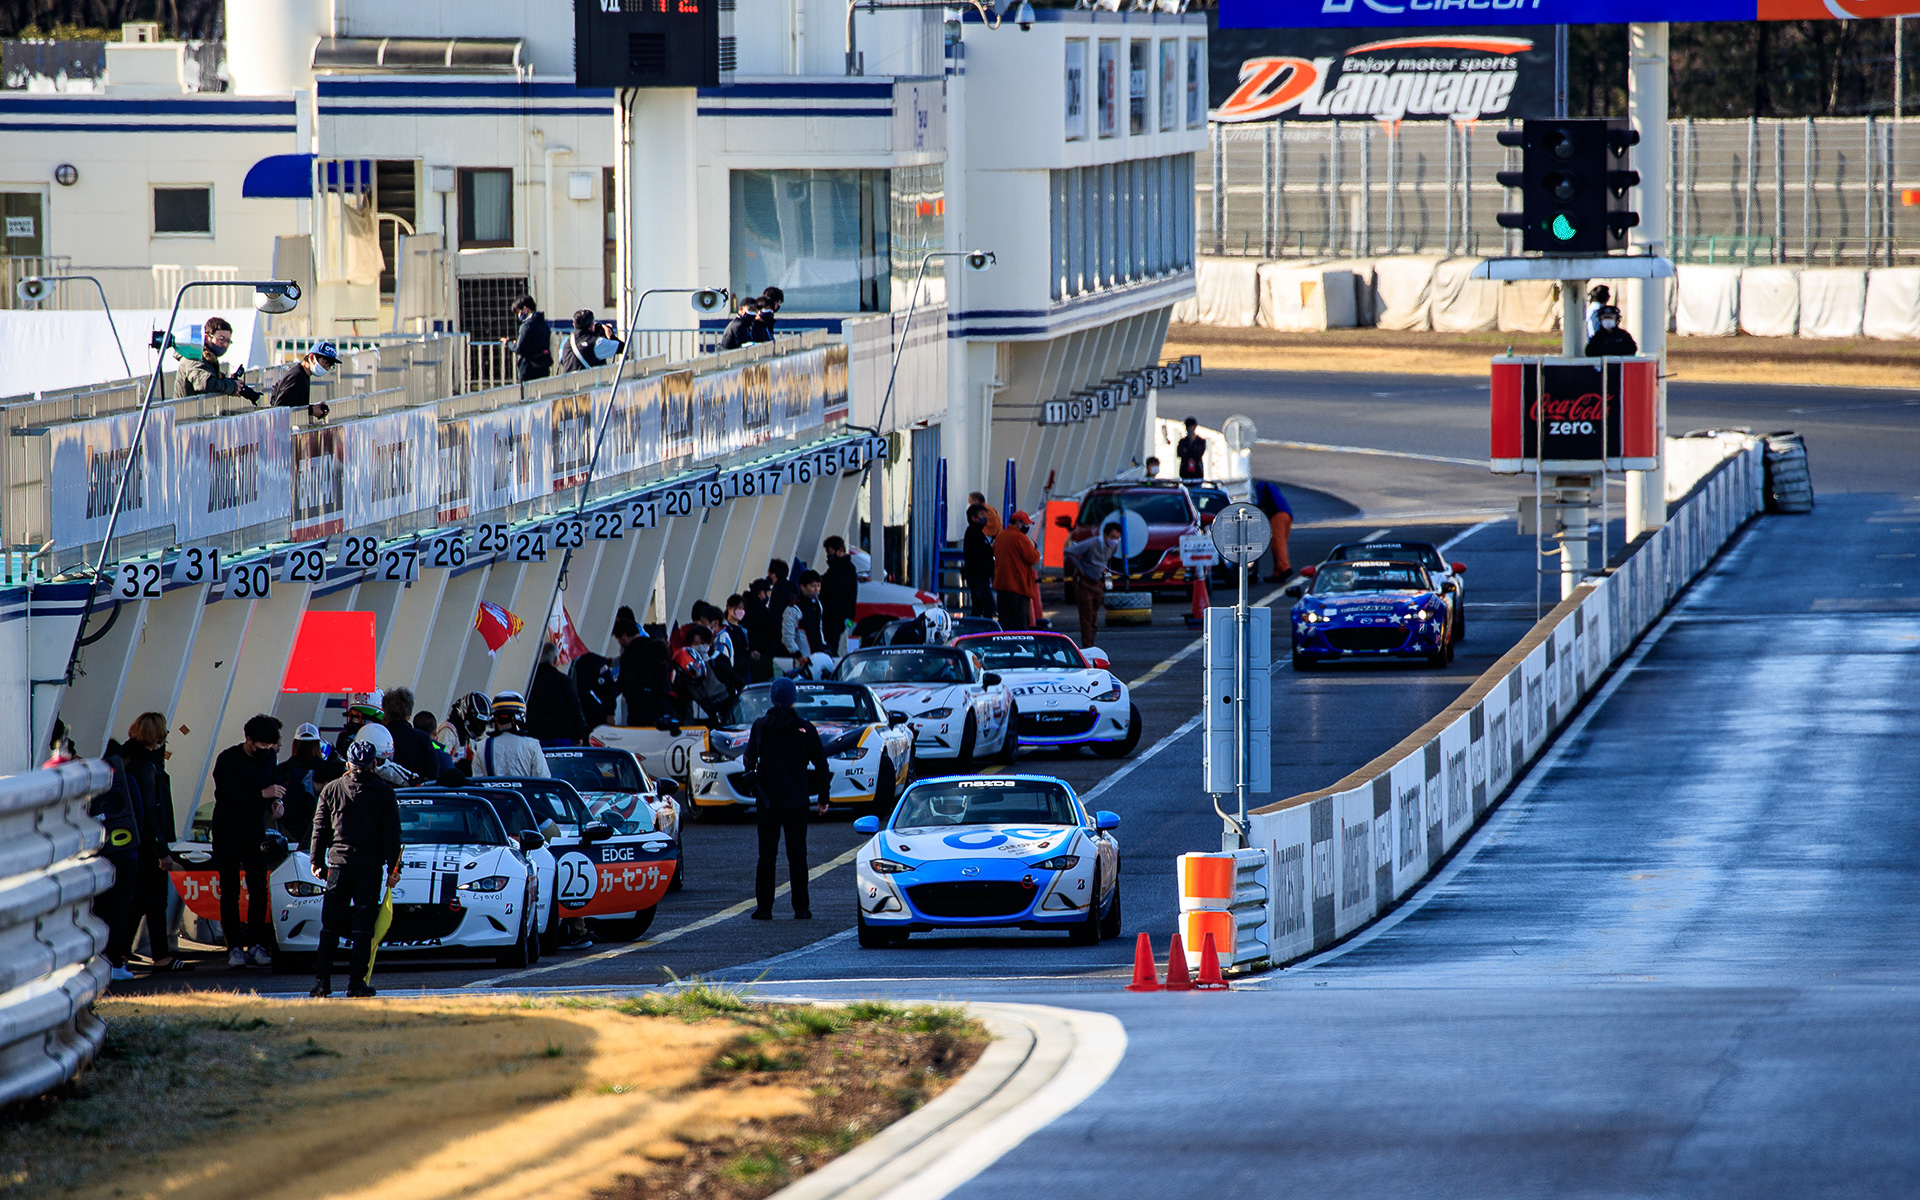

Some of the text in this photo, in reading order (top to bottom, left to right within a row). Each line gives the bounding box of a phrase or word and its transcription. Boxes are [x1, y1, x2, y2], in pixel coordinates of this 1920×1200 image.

[1342, 55, 1518, 73] Enjoy motor sports
[1146, 372, 1153, 385] 5
[1160, 370, 1168, 384] 3
[1174, 366, 1182, 380] 2
[1117, 387, 1124, 401] 7
[1131, 380, 1138, 395] 6
[1085, 398, 1093, 414] 9
[1102, 393, 1110, 408] 8
[1050, 405, 1063, 420] 11
[839, 447, 860, 468] 14
[866, 438, 888, 459] 12
[788, 461, 812, 484] 16
[814, 454, 837, 476] 15
[731, 472, 756, 496] 18
[758, 472, 781, 494] 17
[666, 491, 692, 515] 20
[698, 483, 723, 507] 19
[595, 514, 623, 539] 22
[632, 503, 656, 528] 21
[479, 524, 509, 551] 25
[555, 521, 584, 548] 23
[345, 537, 379, 566] 28
[434, 538, 465, 566] 26
[516, 534, 546, 561] 24
[185, 548, 219, 581] 31
[290, 550, 324, 581] 29
[385, 551, 416, 580] 27
[121, 564, 161, 598] 32
[234, 565, 270, 598] 30
[1011, 684, 1091, 696] arview
[958, 780, 1015, 788] mazda
[602, 848, 635, 862] EDGE
[561, 861, 589, 898] 25
[600, 866, 668, 893] カーセンサー
